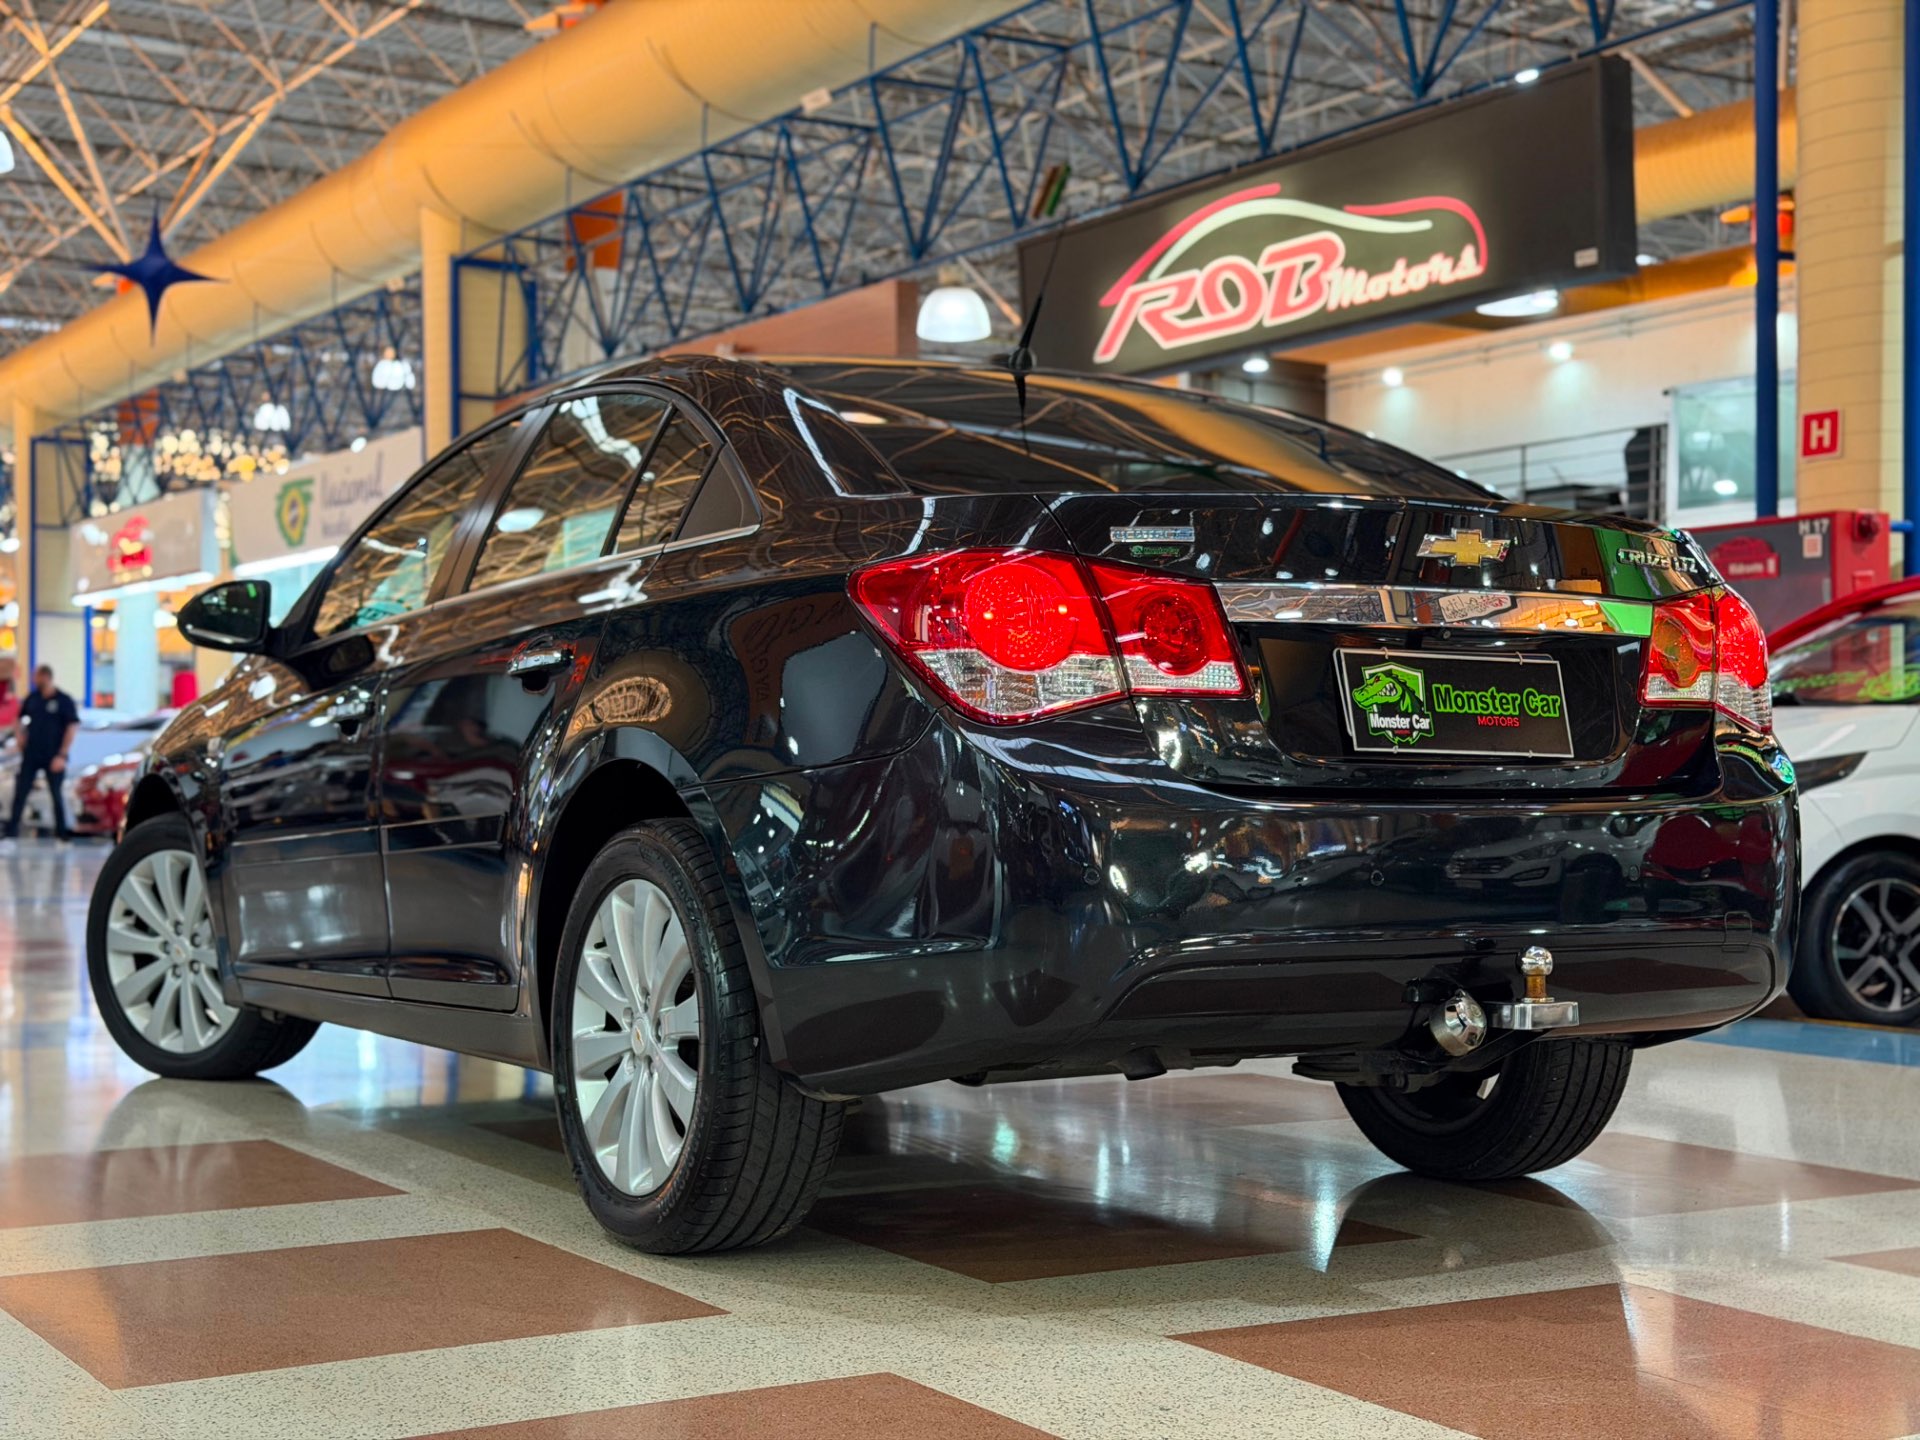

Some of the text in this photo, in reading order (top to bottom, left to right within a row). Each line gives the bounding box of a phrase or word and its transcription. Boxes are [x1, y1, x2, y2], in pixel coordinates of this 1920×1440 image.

[1094, 231, 1482, 363] ROB Motors
[1809, 417, 1832, 450] H
[1432, 683, 1561, 718] Monster Car
[1370, 713, 1430, 730] Monster Car
[1477, 716, 1520, 727] MOTORS
